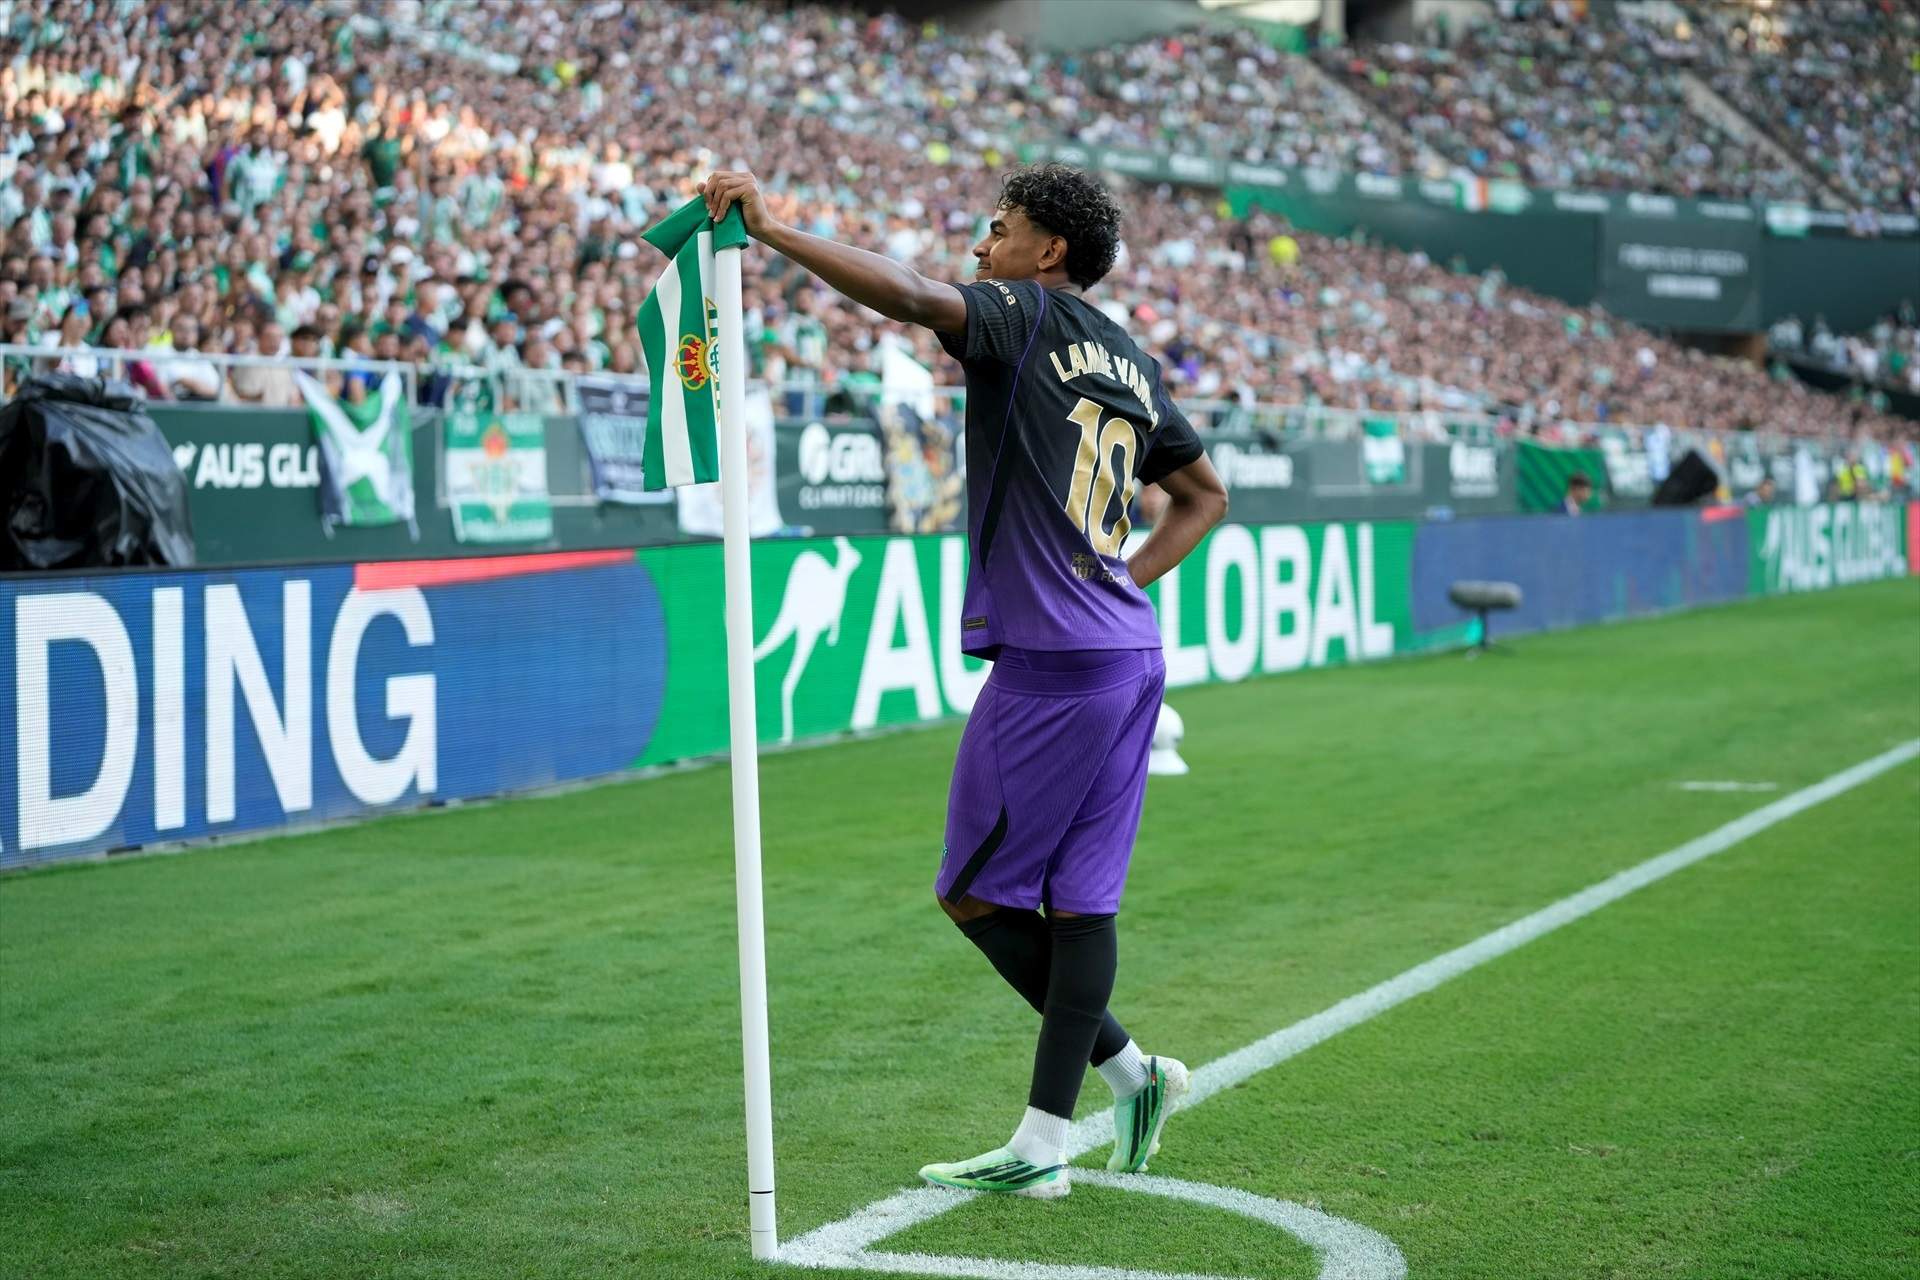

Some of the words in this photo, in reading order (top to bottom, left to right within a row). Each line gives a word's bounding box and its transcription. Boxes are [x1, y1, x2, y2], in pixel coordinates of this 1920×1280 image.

[194, 443, 265, 489] AUS
[1066, 397, 1137, 559] 10
[1120, 522, 1395, 686] LOBAL
[0, 579, 437, 850] DING
